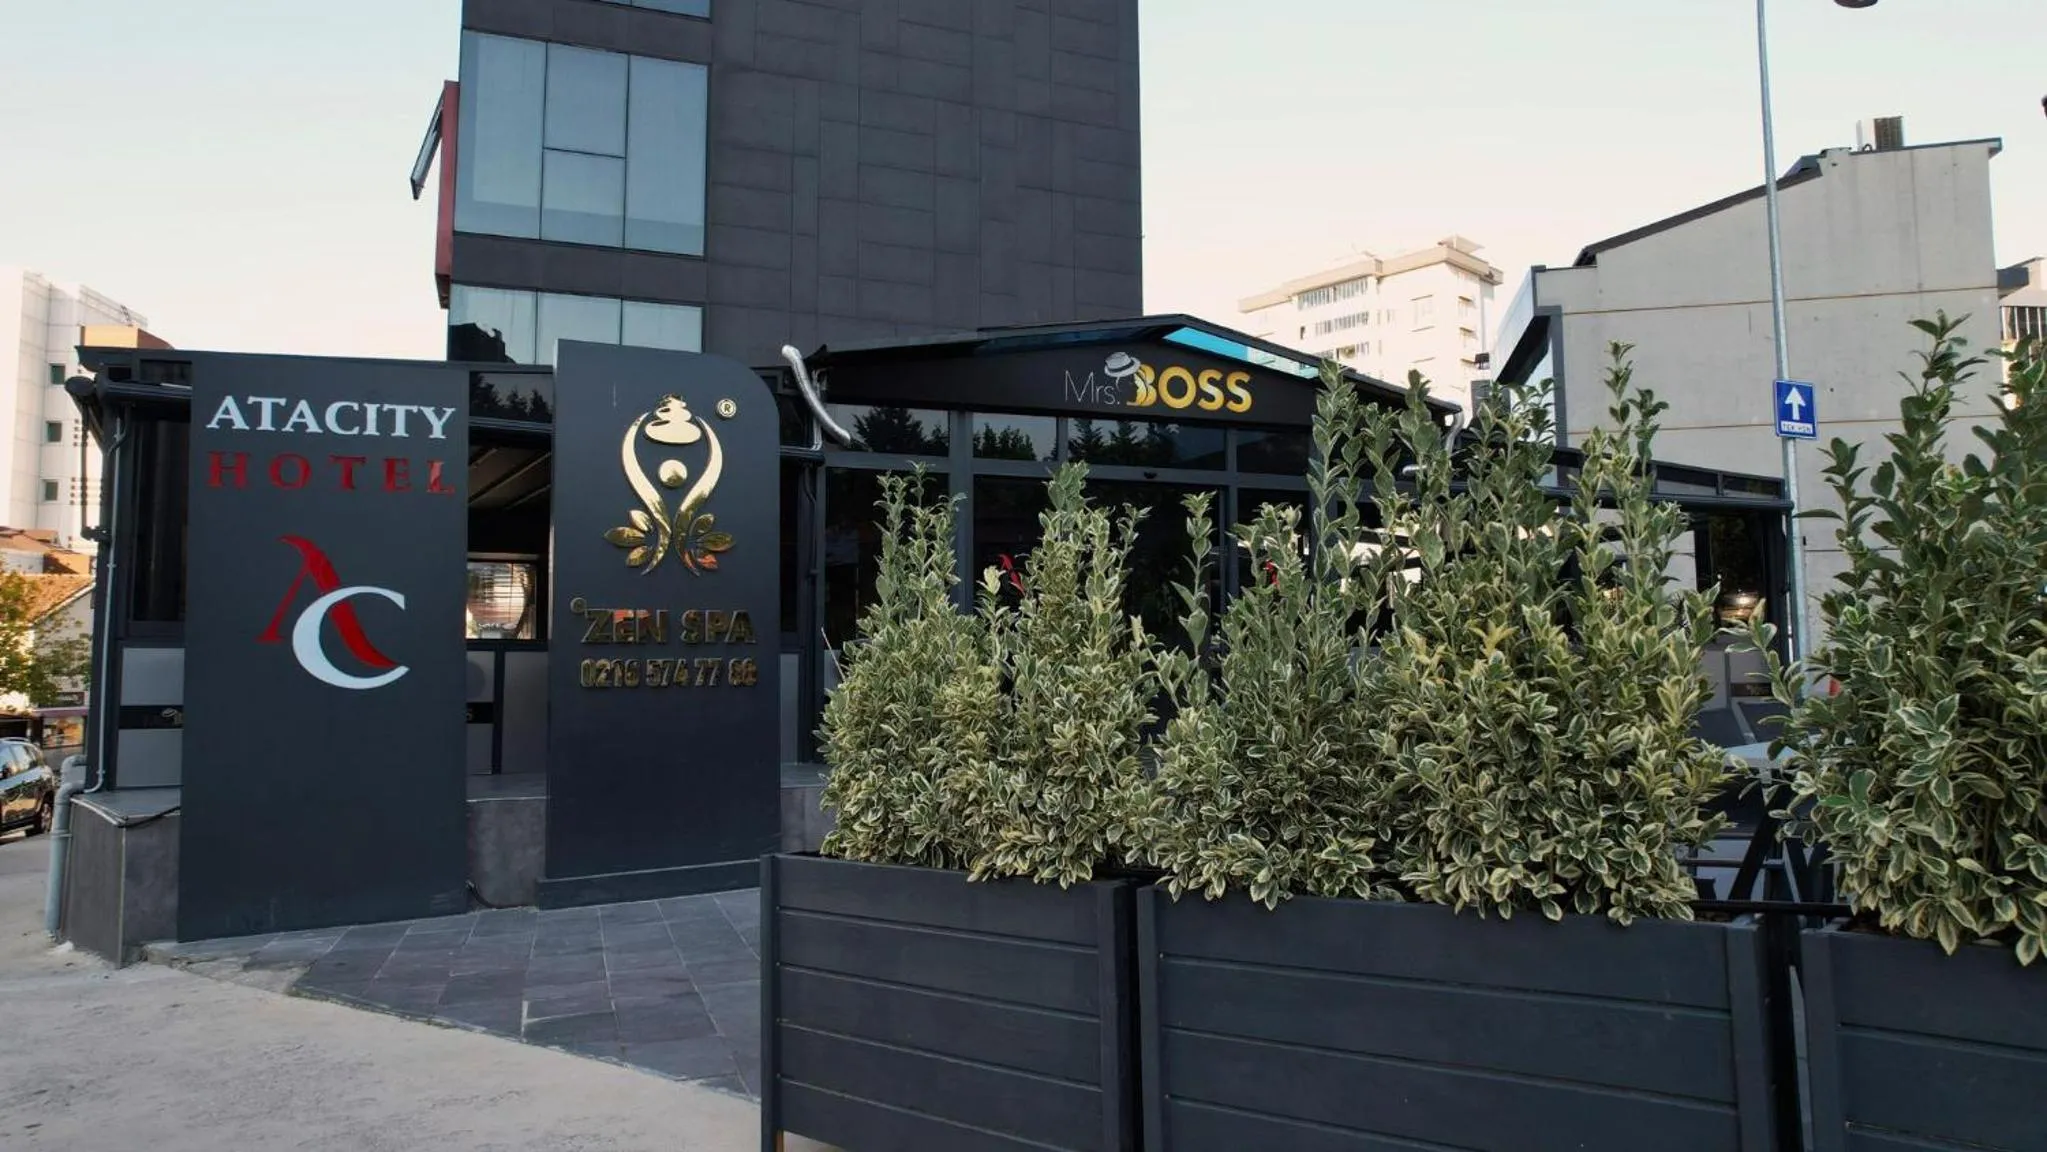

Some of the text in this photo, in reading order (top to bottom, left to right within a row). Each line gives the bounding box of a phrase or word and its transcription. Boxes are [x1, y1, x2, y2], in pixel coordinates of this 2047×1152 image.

[1064, 363, 1253, 414] Mrs. BOSS
[206, 395, 456, 440] ATACITY
[206, 450, 456, 496] HOTEL
[581, 607, 757, 645] ZEN SPA
[579, 658, 641, 689] 0216
[646, 657, 690, 688] 574
[694, 657, 723, 687] 77
